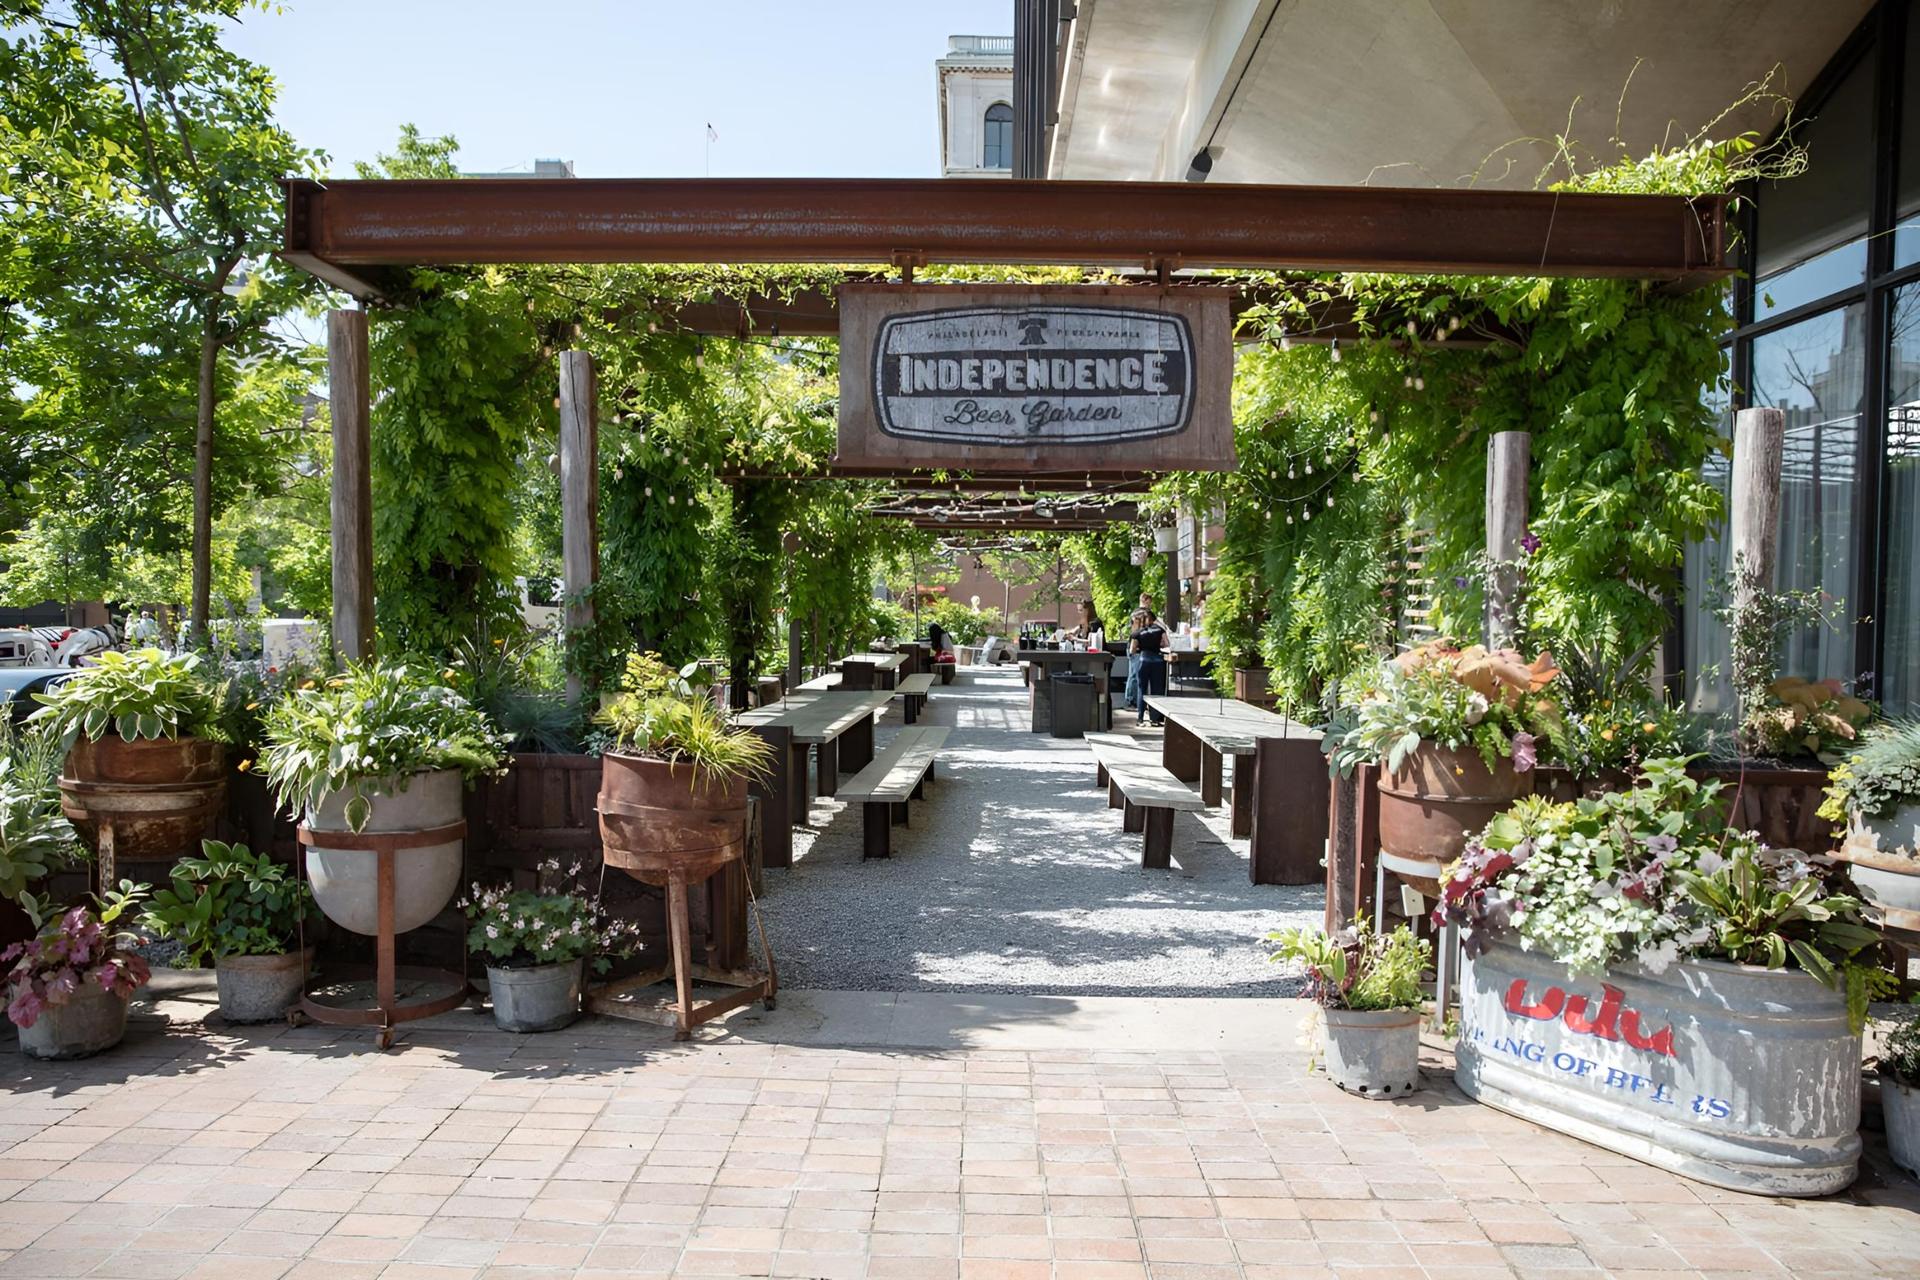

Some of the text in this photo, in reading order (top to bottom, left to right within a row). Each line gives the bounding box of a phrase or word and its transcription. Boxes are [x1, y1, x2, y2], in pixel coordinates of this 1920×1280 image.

[899, 353, 1168, 394] INDEPENDENCE
[944, 399, 1122, 433] Beer Garden
[1553, 1052, 1599, 1077] OF
